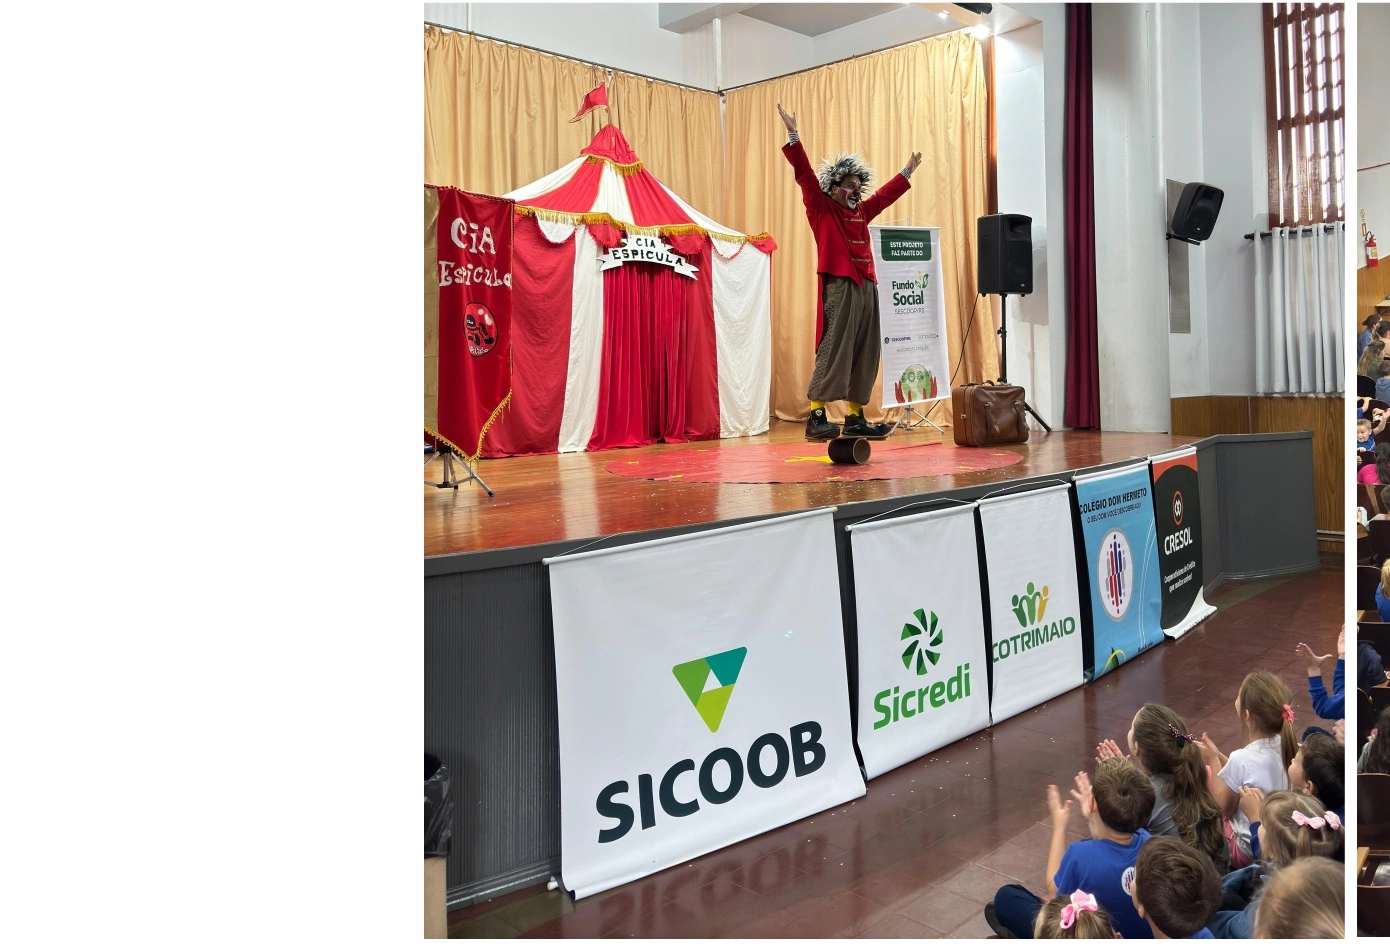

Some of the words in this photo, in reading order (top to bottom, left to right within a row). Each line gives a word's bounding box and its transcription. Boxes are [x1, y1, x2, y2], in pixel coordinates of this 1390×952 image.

[612, 248, 684, 266] ESPICULA
[636, 238, 656, 249] CIA
[892, 280, 915, 290] Fundo
[893, 290, 924, 306] Social
[1080, 498, 1107, 515] COLÉGIO
[1108, 495, 1122, 507] DOM
[1122, 487, 1147, 503] HERMETO
[1164, 526, 1193, 556] CRESOL
[992, 616, 1076, 663] COTRIMAIO
[873, 662, 971, 730] Sicredi
[595, 720, 827, 843] SICOOB
